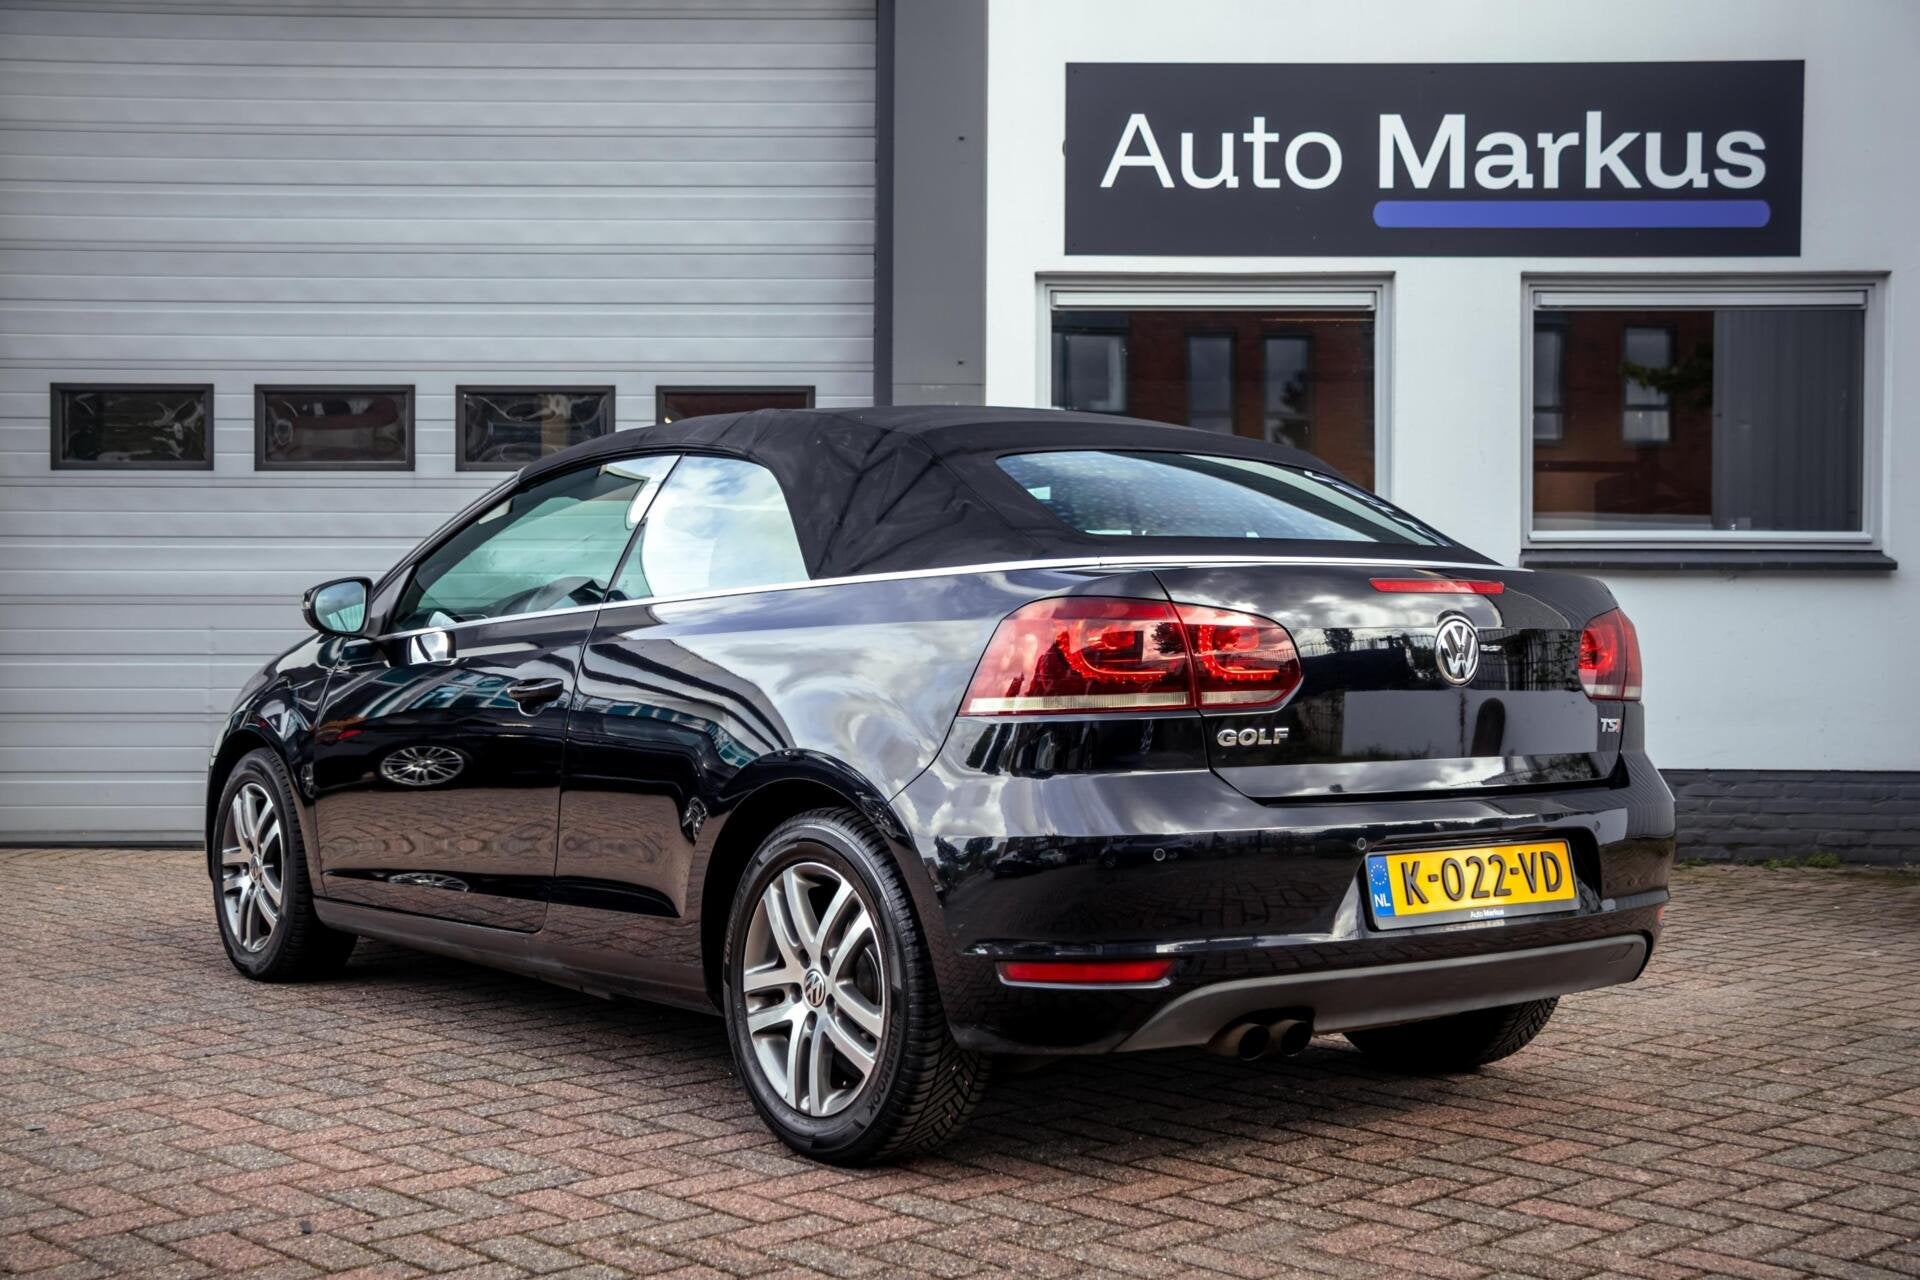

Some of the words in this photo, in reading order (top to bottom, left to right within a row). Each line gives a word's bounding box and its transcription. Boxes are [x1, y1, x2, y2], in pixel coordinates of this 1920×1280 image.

[1100, 113, 1343, 190] Auto
[1378, 110, 1767, 190] Markus
[1217, 727, 1290, 747] GOLF
[1401, 851, 1563, 906] K-022-VD
[1374, 893, 1391, 908] NL
[1470, 910, 1483, 918] Auto
